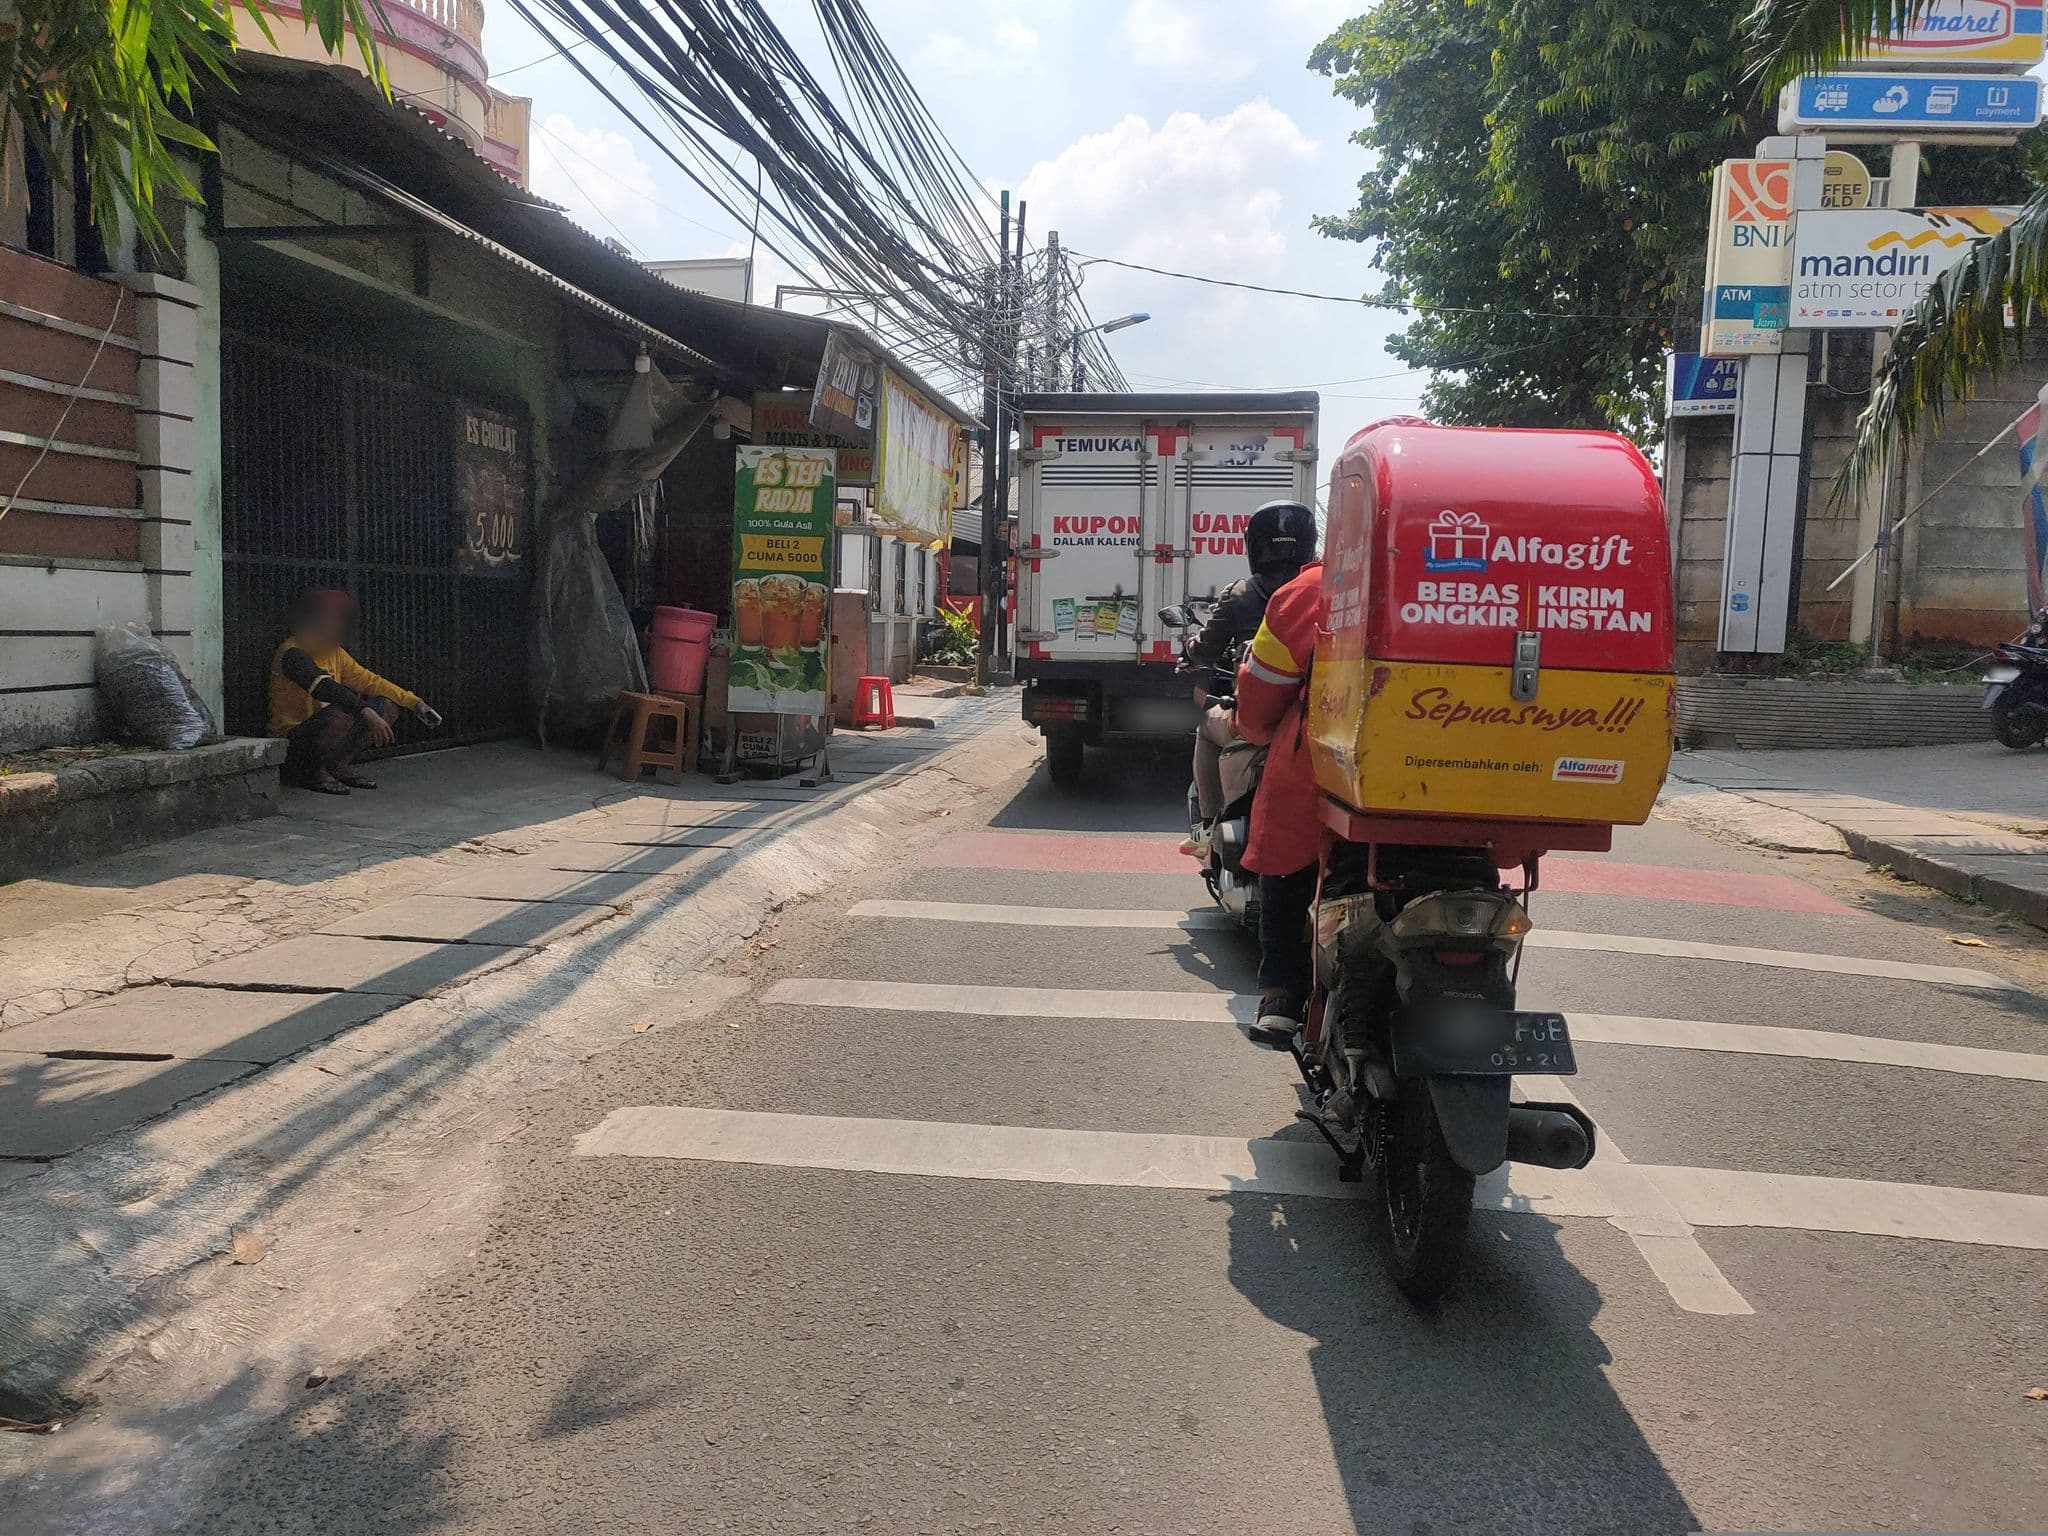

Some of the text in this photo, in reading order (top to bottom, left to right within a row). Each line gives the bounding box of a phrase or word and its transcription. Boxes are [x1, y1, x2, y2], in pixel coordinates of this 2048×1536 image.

[1929, 103, 1951, 111] DEBIT
[1975, 107, 2021, 117] payment
[1824, 184, 1862, 195] FFEE
[1820, 196, 1853, 208] OLD
[1733, 225, 1779, 247] BNI
[1800, 248, 1930, 277] mandiri
[1721, 289, 1752, 301] ATM
[1798, 281, 1841, 298] atm
[1850, 281, 1909, 298] setor
[1760, 303, 1778, 317] 24
[1755, 318, 1777, 328] Jam
[766, 432, 809, 446] MANIS
[812, 434, 822, 447] &
[1055, 438, 1144, 452] TEMUKAN
[753, 457, 784, 486] ES
[785, 459, 825, 487] TEH
[754, 487, 815, 513] RADJA
[748, 519, 813, 530] 100% Gula Asli
[1053, 516, 1141, 534] KUPON
[1192, 514, 1252, 534] UAN
[767, 539, 800, 550] BELI 2
[1053, 537, 1094, 547] DALAM
[1191, 537, 1248, 555] TUN
[747, 551, 818, 563] CUMA 5000
[1491, 535, 1634, 571] Alfagift
[1417, 581, 1520, 605] BEBAS
[1538, 585, 1625, 609] KIRIM
[1400, 602, 1519, 628] ONGKIR
[1537, 607, 1652, 633] INSTAN
[1404, 686, 1646, 734] Sepuasnya!!!
[742, 735, 764, 743] BELI
[742, 743, 771, 752] CUMA
[1404, 755, 1543, 773] Dipersembahkan oleh:
[1557, 759, 1620, 775] Alfamart
[1442, 991, 1485, 1000] HONDA
